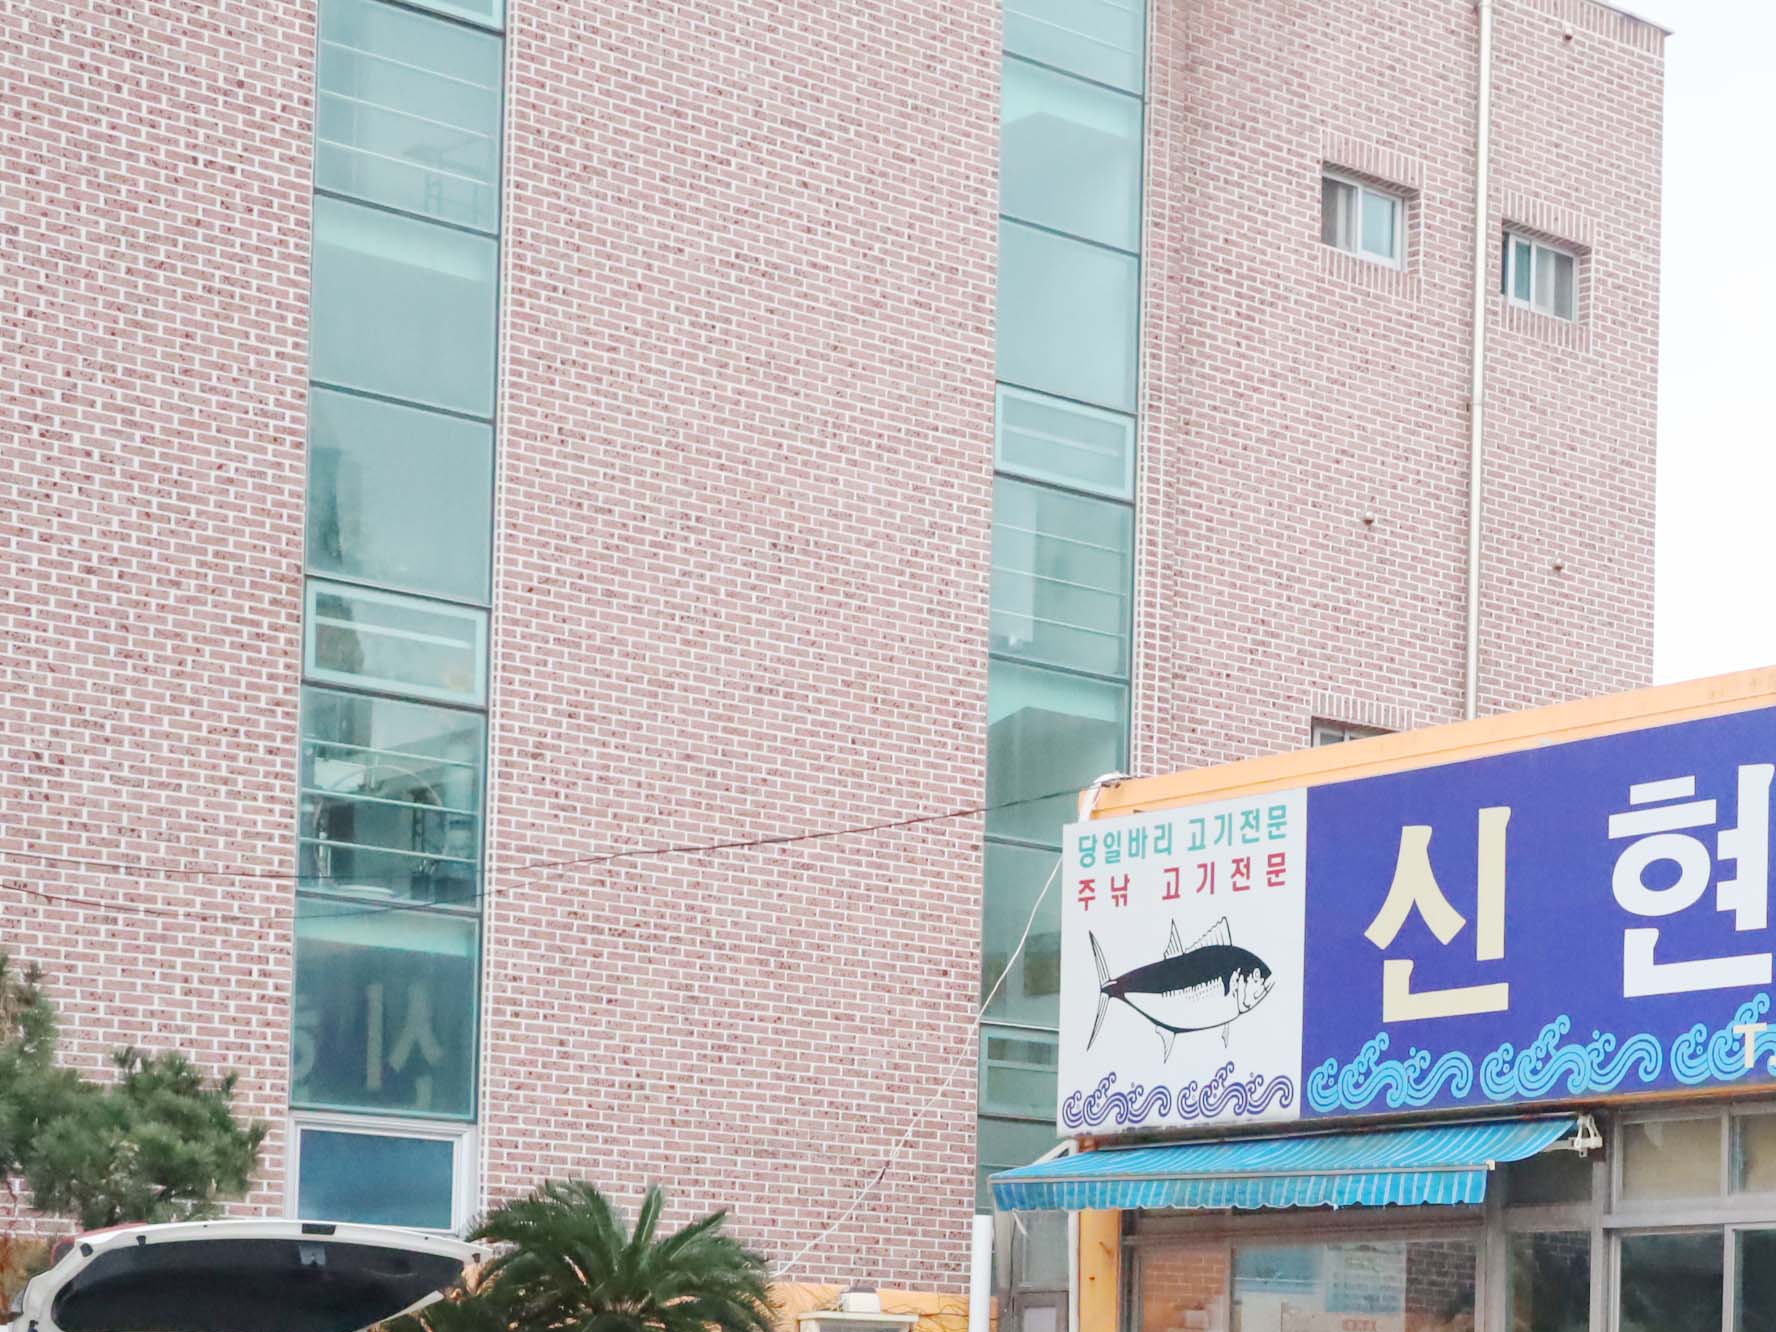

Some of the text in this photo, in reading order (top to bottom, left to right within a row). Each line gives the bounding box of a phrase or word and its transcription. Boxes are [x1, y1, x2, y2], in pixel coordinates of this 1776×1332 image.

[1078, 804, 1289, 869] 당일바리 고기전문
[1077, 873, 1131, 912] 주낚
